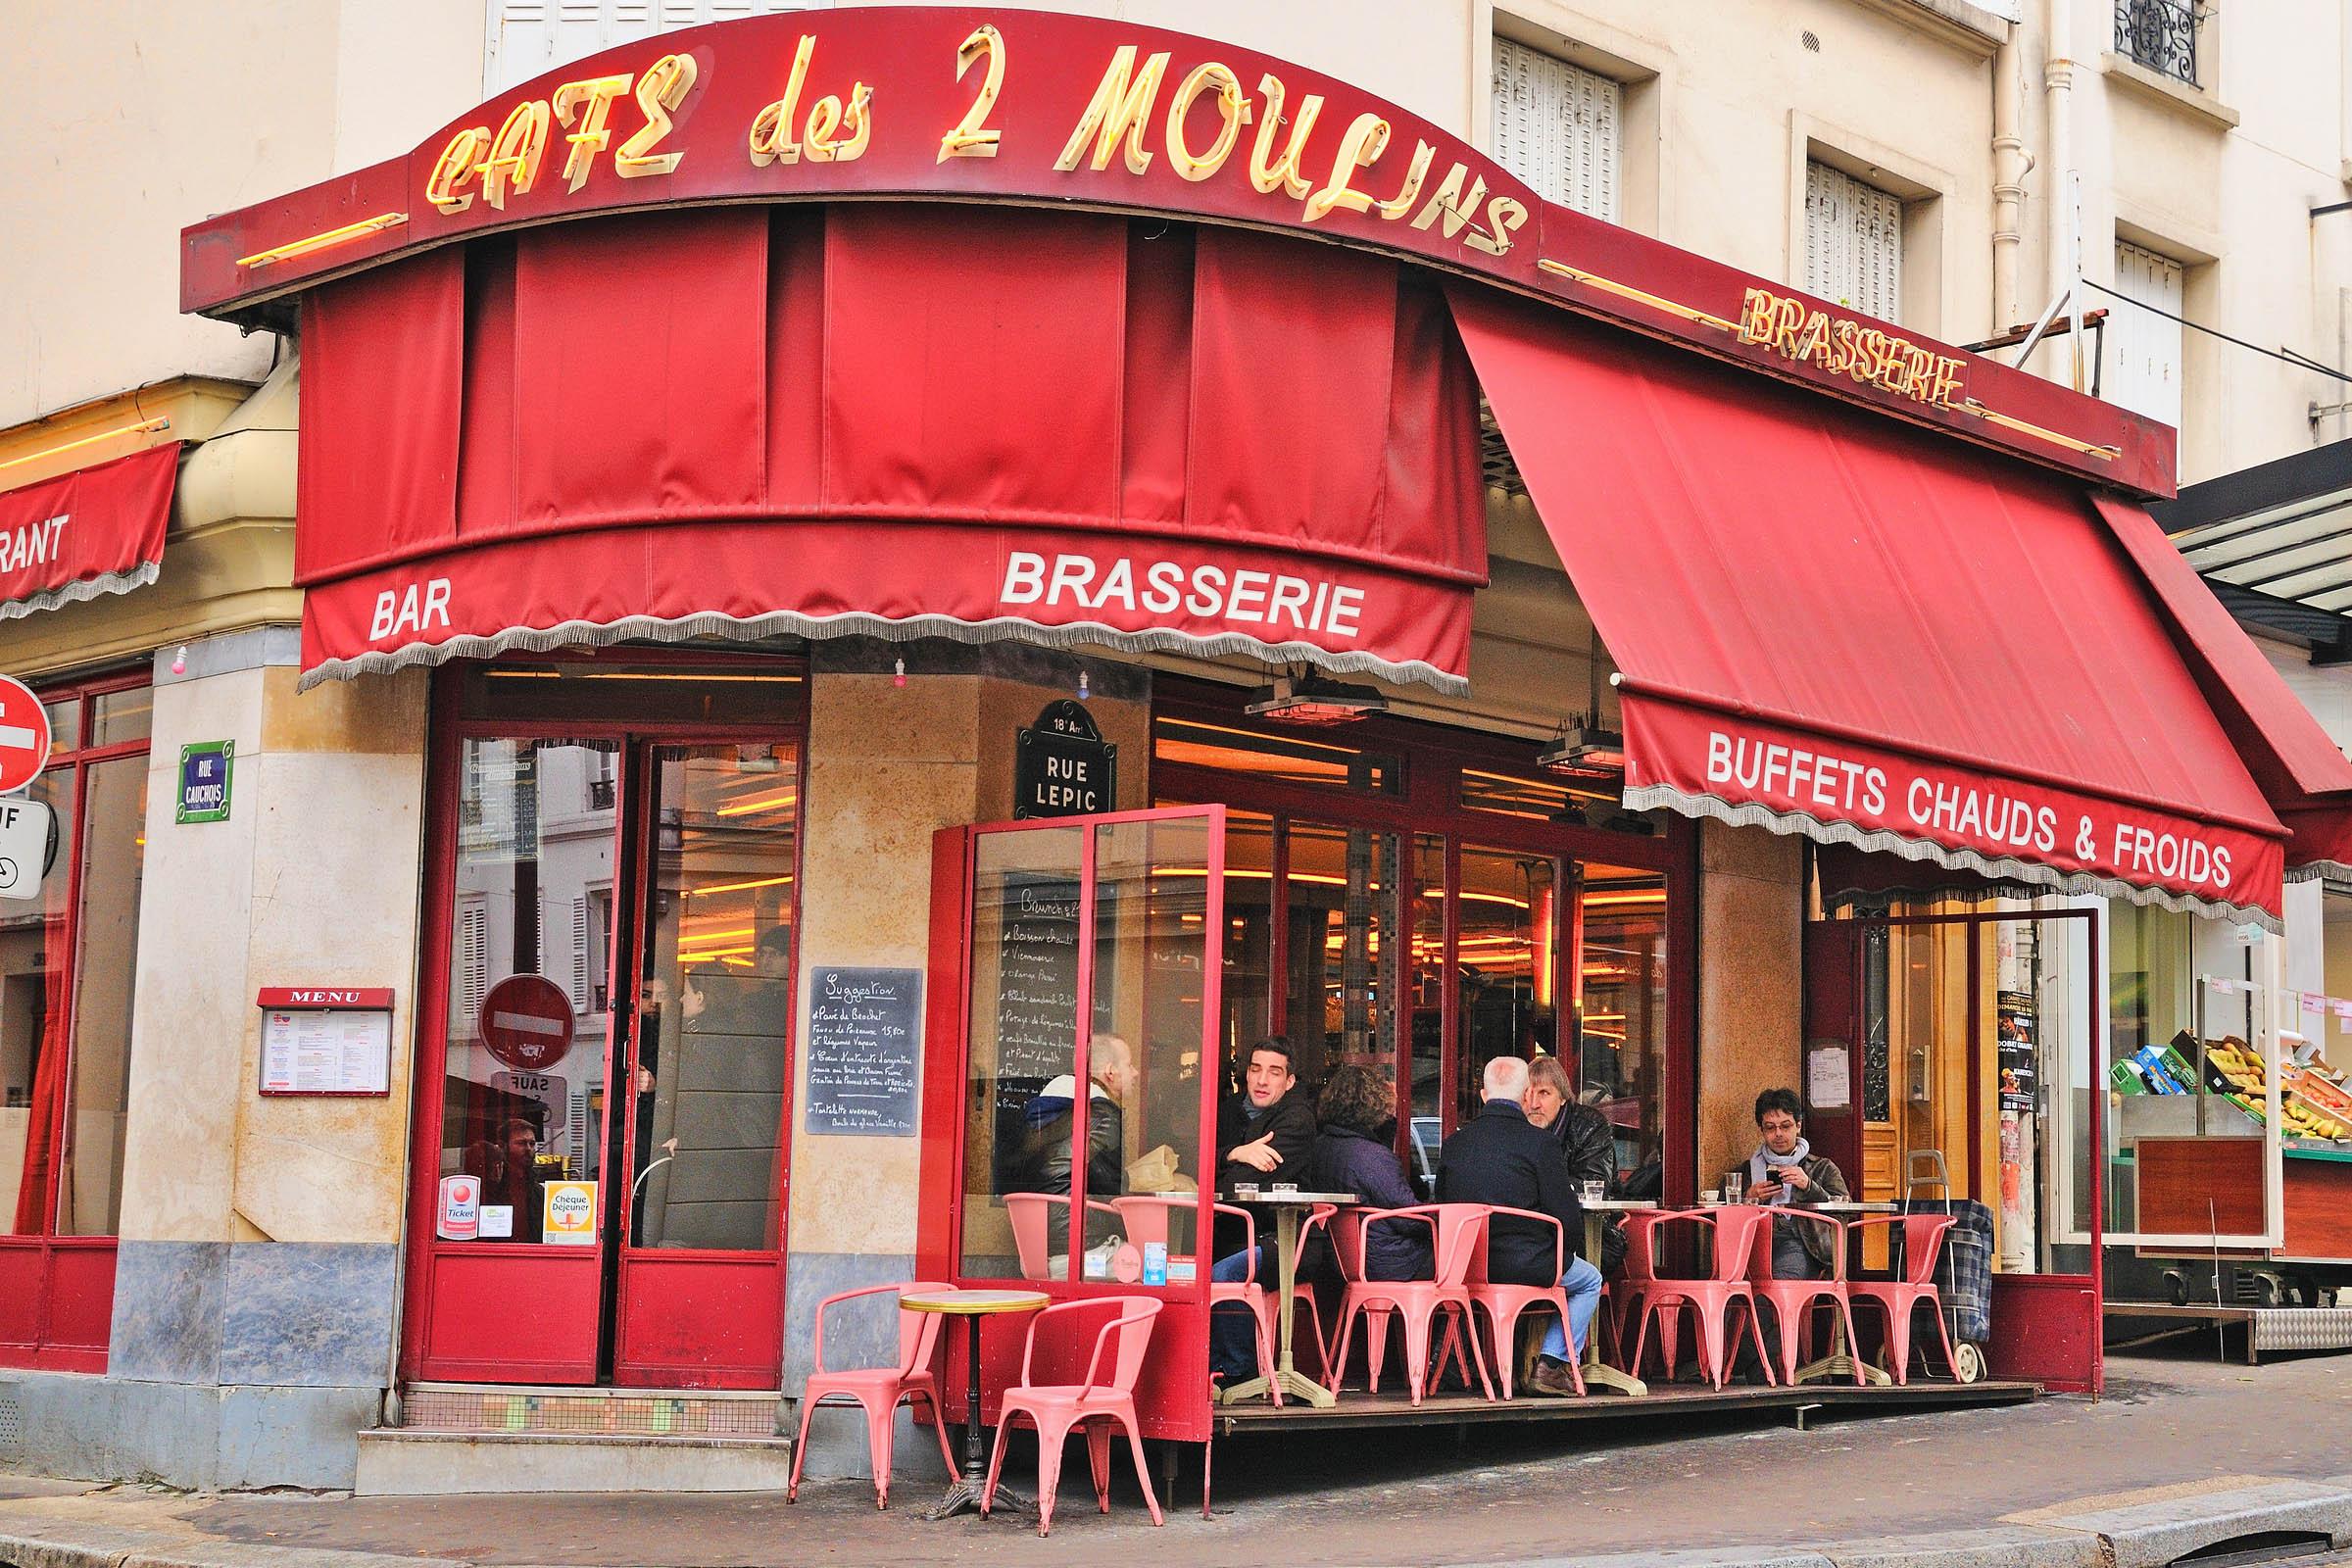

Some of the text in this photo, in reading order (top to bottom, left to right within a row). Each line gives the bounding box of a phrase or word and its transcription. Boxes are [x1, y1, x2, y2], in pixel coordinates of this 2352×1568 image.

[426, 23, 1529, 257] CAFE des 2 MOULINS
[1738, 287, 1967, 412] BRASSERIE
[1001, 552, 1365, 637] BRASSERIE
[368, 577, 452, 642] BAR
[198, 760, 213, 777] RUE
[1048, 756, 1087, 782] RUE
[185, 784, 221, 804] CAUCHOIS
[1037, 783, 1096, 810] LEPIC
[1707, 731, 2232, 889] BUFFETS CHAUDS & FROIDS
[1021, 888, 1062, 914] Brunch
[1013, 924, 1045, 942] Boisson
[290, 991, 361, 1003] MENU
[819, 1005, 839, 1020] Pavé
[840, 1008, 849, 1020] de
[812, 1036, 821, 1045] et
[448, 1208, 474, 1218] Ticket
